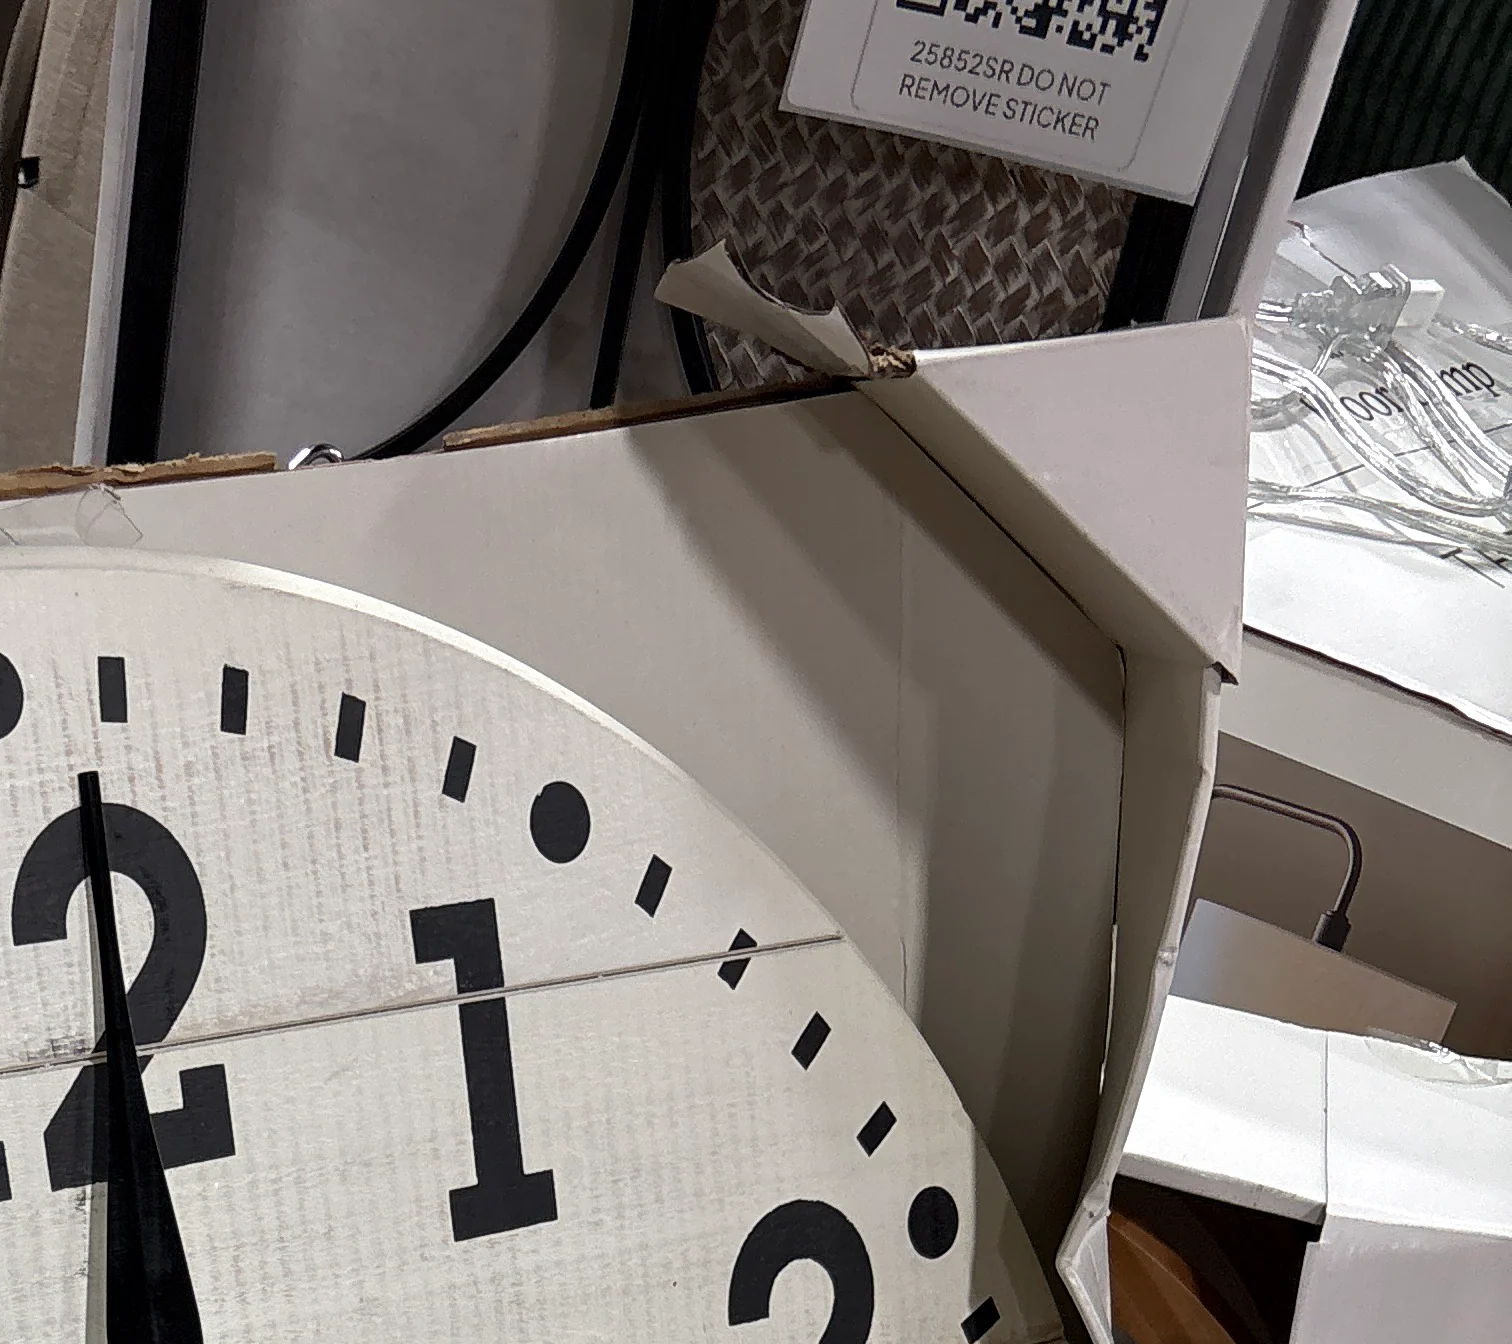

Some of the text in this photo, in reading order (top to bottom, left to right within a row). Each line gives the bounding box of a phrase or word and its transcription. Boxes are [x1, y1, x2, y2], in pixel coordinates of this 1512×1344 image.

[910, 40, 1111, 105] 25852SR DO NOT
[899, 74, 1100, 141] REMOVE STICKER
[410, 898, 557, 1242] 1
